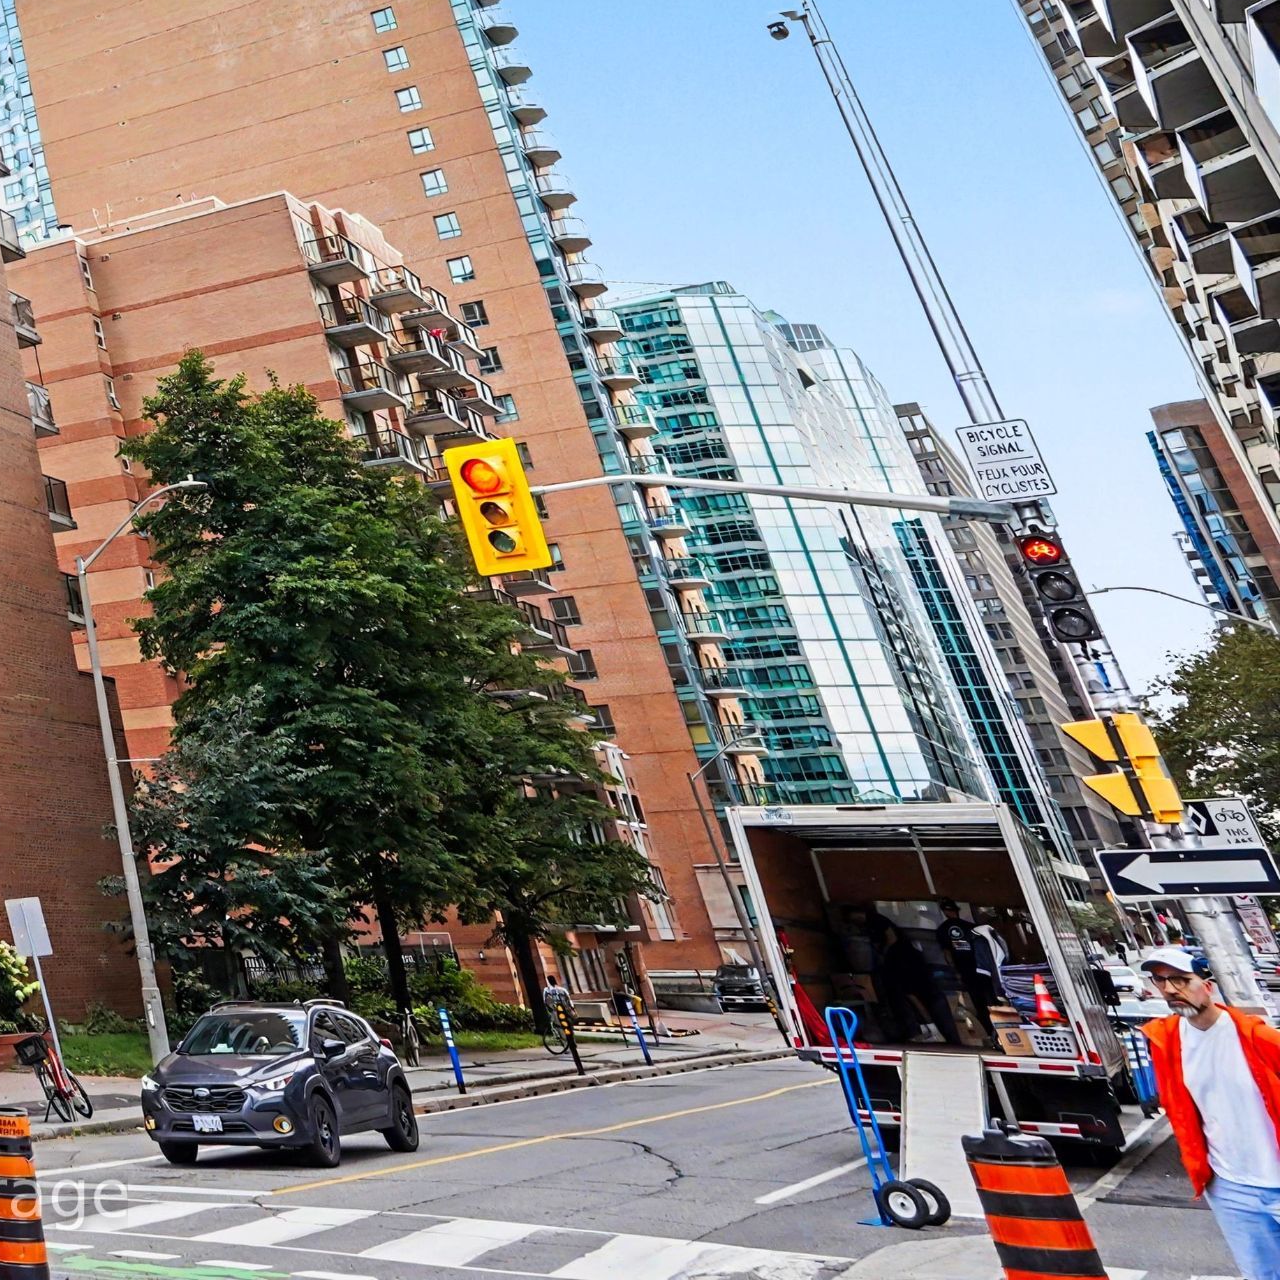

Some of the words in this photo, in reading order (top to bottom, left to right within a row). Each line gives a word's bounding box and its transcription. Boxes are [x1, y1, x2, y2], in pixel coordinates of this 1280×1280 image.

[966, 425, 1023, 443] BICYCLE
[977, 441, 1024, 457] SIGNAL
[977, 467, 1010, 481] FEUX
[985, 478, 1050, 497] CYCLISTES
